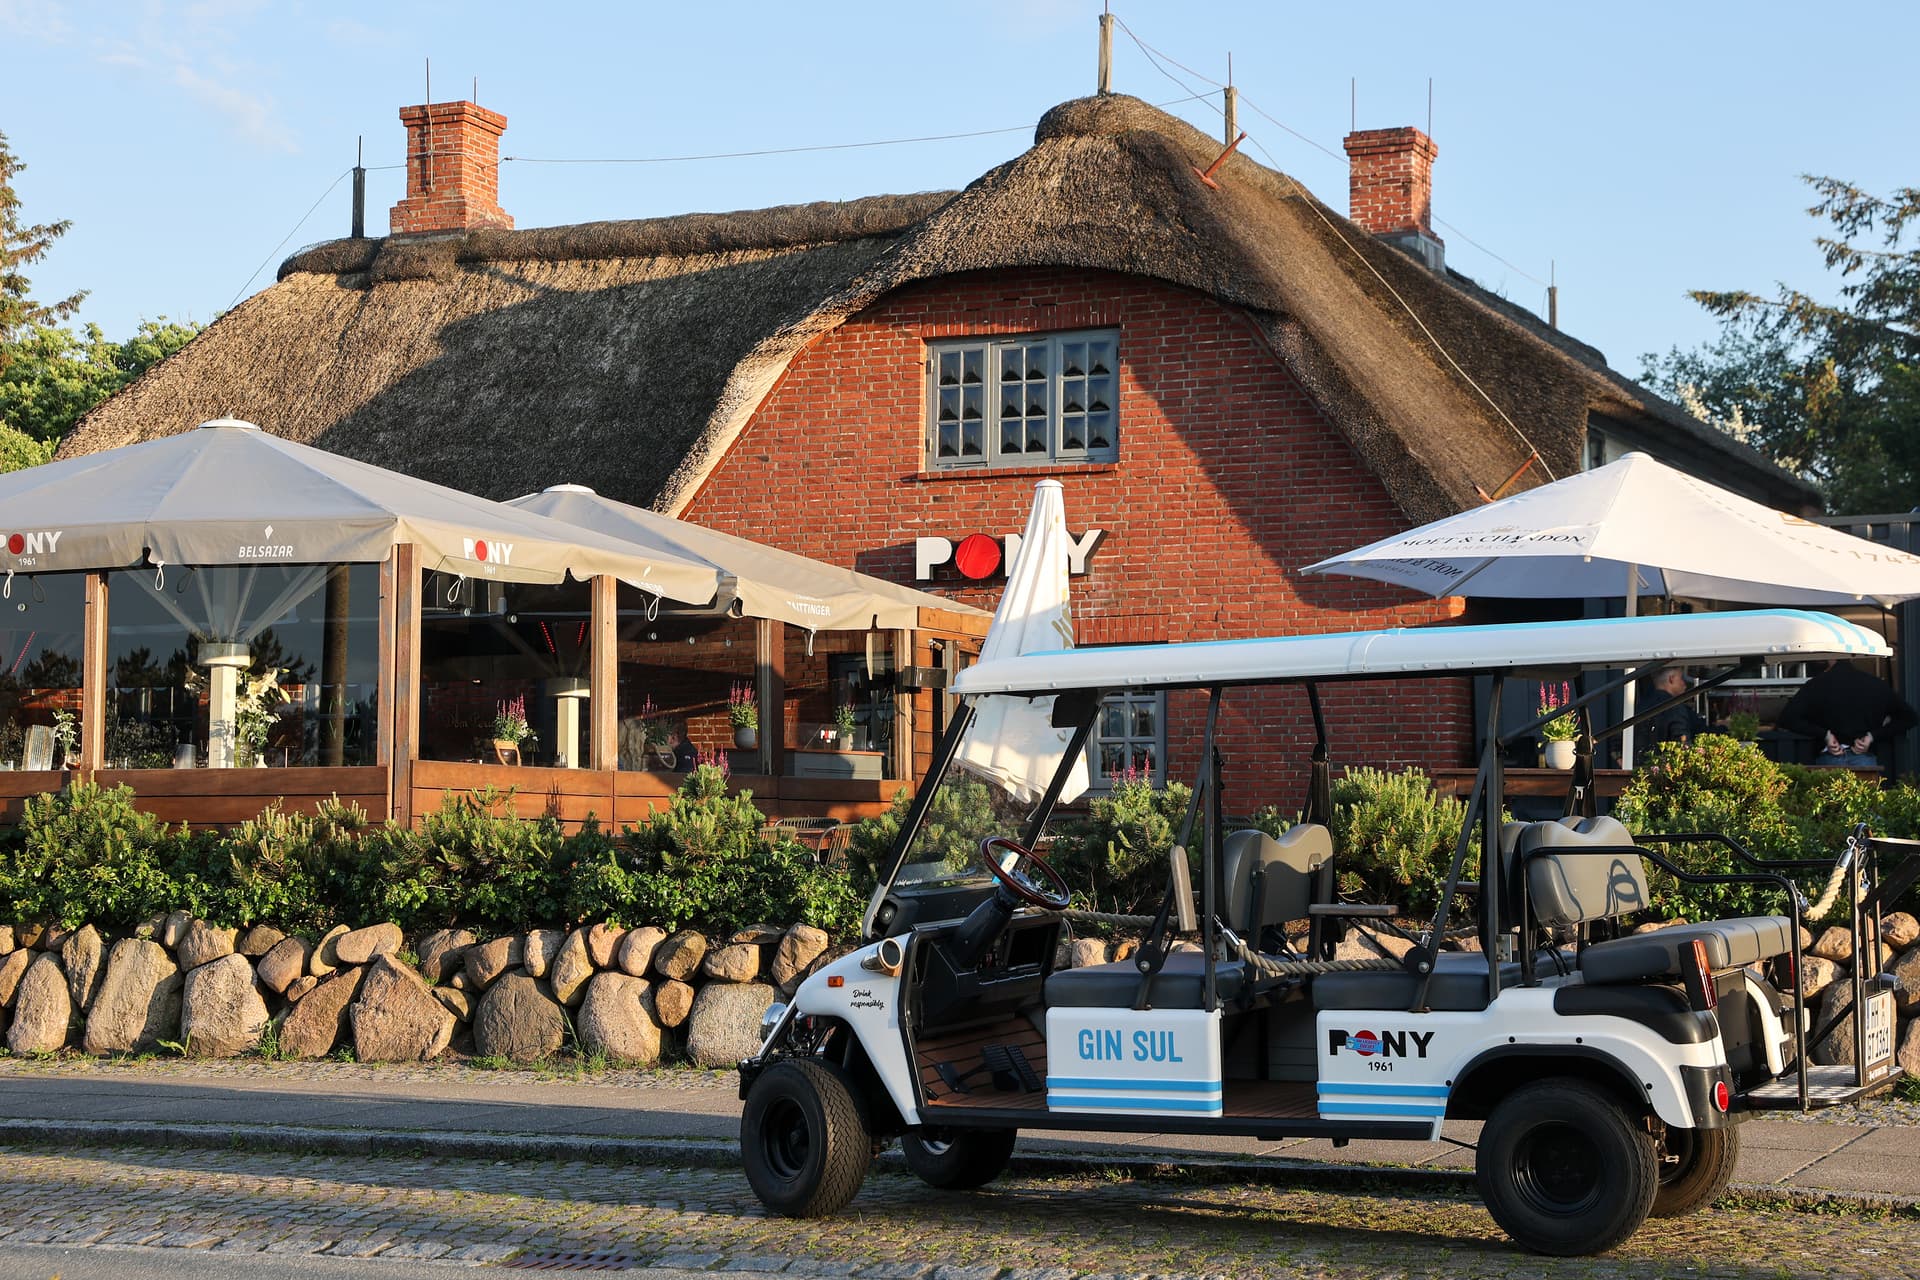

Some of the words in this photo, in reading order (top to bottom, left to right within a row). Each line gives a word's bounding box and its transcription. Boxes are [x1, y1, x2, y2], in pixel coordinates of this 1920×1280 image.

[239, 545, 293, 558] BELSAZAR
[463, 537, 513, 565] PONY
[18, 557, 36, 566] 1961
[853, 989, 872, 999] Drink
[850, 1000, 884, 1011] responsibly
[1078, 1029, 1122, 1060] GIN
[1132, 1030, 1183, 1062] SUL
[1368, 1062, 1393, 1072] 1961
